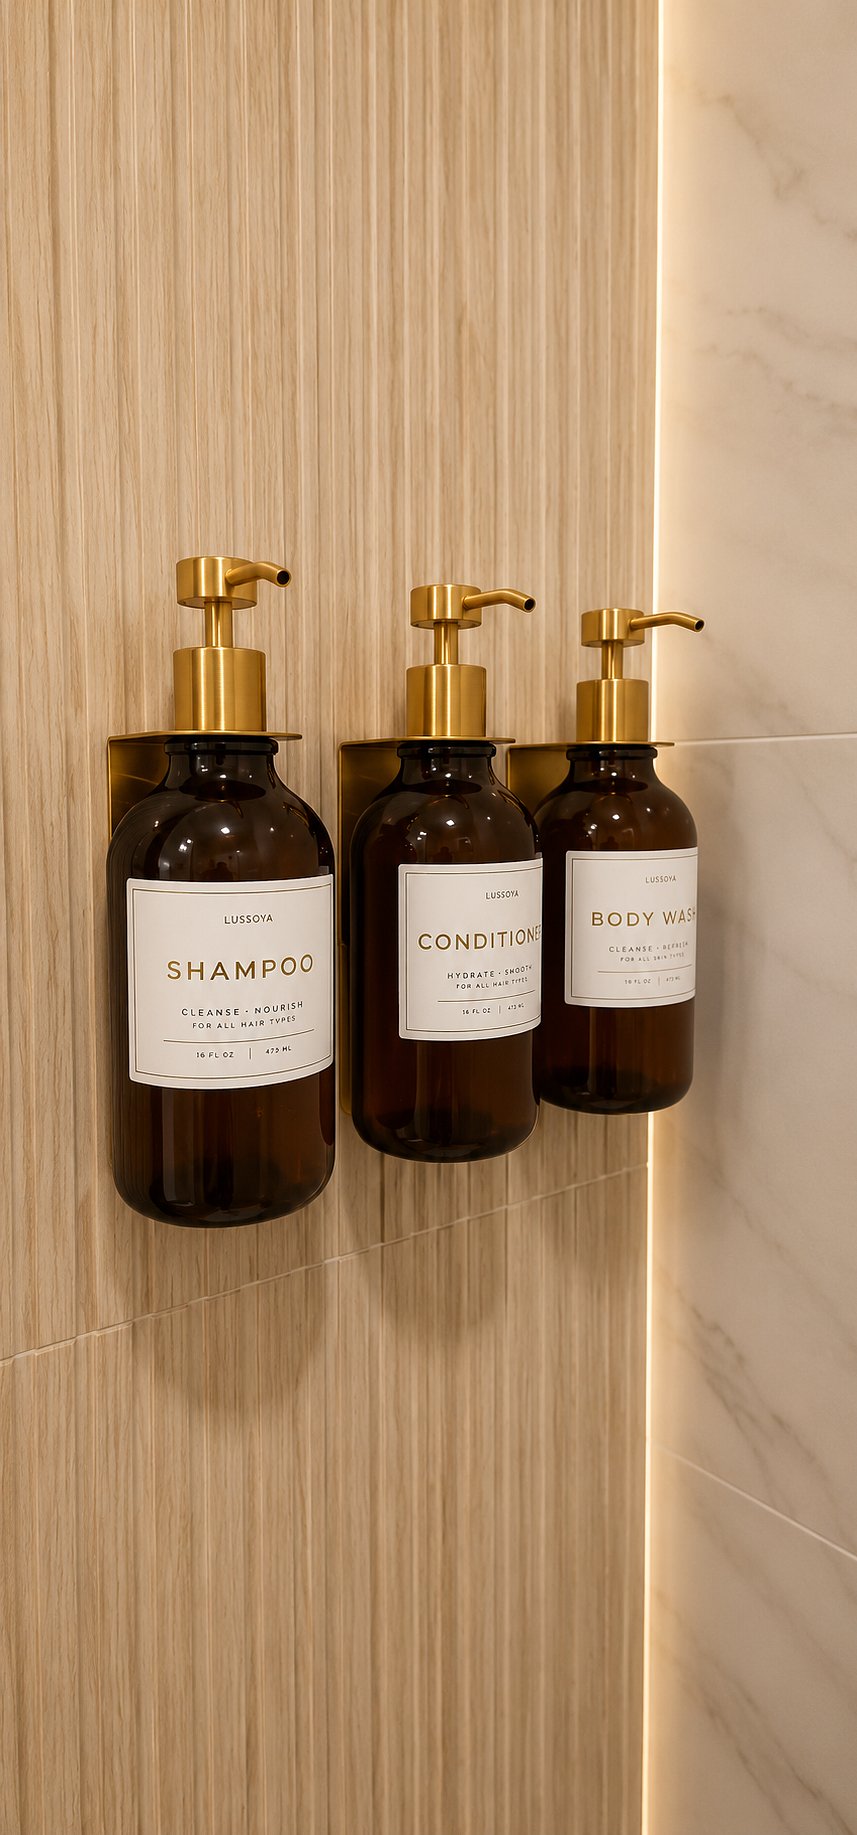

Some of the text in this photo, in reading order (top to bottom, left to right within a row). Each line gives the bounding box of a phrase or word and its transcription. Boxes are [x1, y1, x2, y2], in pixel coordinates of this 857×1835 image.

[645, 875, 677, 884] LUSSOYA
[485, 890, 520, 900] LUSSOYA
[224, 914, 274, 925] LUSSOYA
[591, 911, 655, 927] BODY
[167, 954, 314, 981] SHAMPOO
[447, 970, 495, 980] HYDRATE
[181, 1001, 304, 1017] CLEANSE NOURISH
[240, 1019, 265, 1028] HAIR
